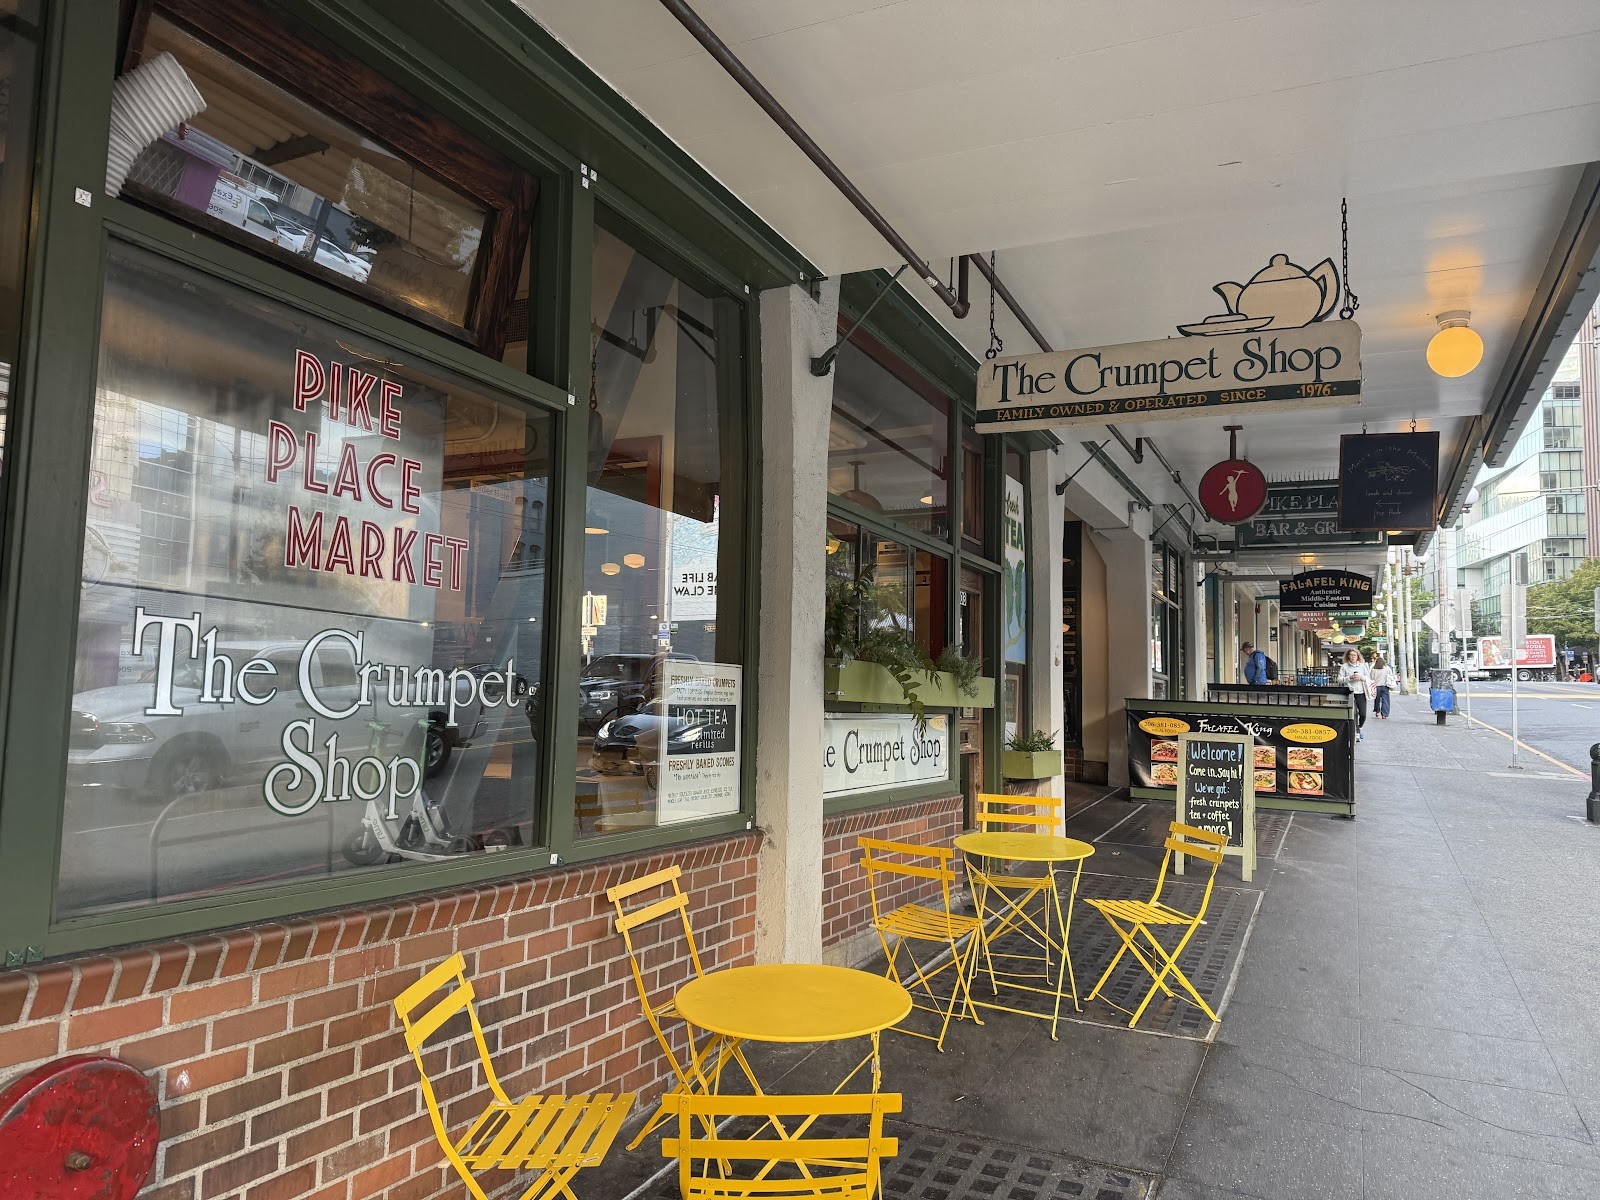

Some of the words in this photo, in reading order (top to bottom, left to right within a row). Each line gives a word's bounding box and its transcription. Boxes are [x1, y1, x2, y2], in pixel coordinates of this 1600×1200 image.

[992, 361, 1056, 403] The
[1064, 347, 1221, 396] Crumpet
[1233, 336, 1342, 383] Shop
[293, 348, 403, 441] PIKE
[996, 407, 1045, 421] FAMILY
[1050, 403, 1105, 417] OWNED
[1108, 401, 1120, 413] &
[1124, 394, 1208, 411] OPERATED
[1220, 389, 1266, 403] SINCE
[266, 419, 423, 516] PLACE
[1269, 495, 1303, 511] IKE
[1004, 515, 1024, 553] TEA
[1255, 522, 1291, 537] BAR
[1294, 521, 1309, 535] &
[284, 505, 470, 592] MARKET
[1281, 577, 1336, 593] FALAFEL
[1340, 577, 1371, 591] KING
[132, 606, 279, 717] The
[298, 628, 520, 727] Crumpet
[676, 708, 702, 726] HOT
[706, 708, 728, 725] TEA
[1244, 721, 1273, 738] King
[843, 728, 905, 774] Crumpet
[910, 725, 941, 767] Shop
[1190, 742, 1244, 762] Welcome!
[263, 718, 422, 821] Shop
[668, 759, 694, 771] FRESHLY
[695, 758, 715, 769] BAKED
[1189, 764, 1206, 777] Come
[1189, 796, 1207, 809] fresh
[1209, 799, 1240, 812] crumpets
[1188, 809, 1202, 820] tea
[1207, 810, 1230, 822] coffee
